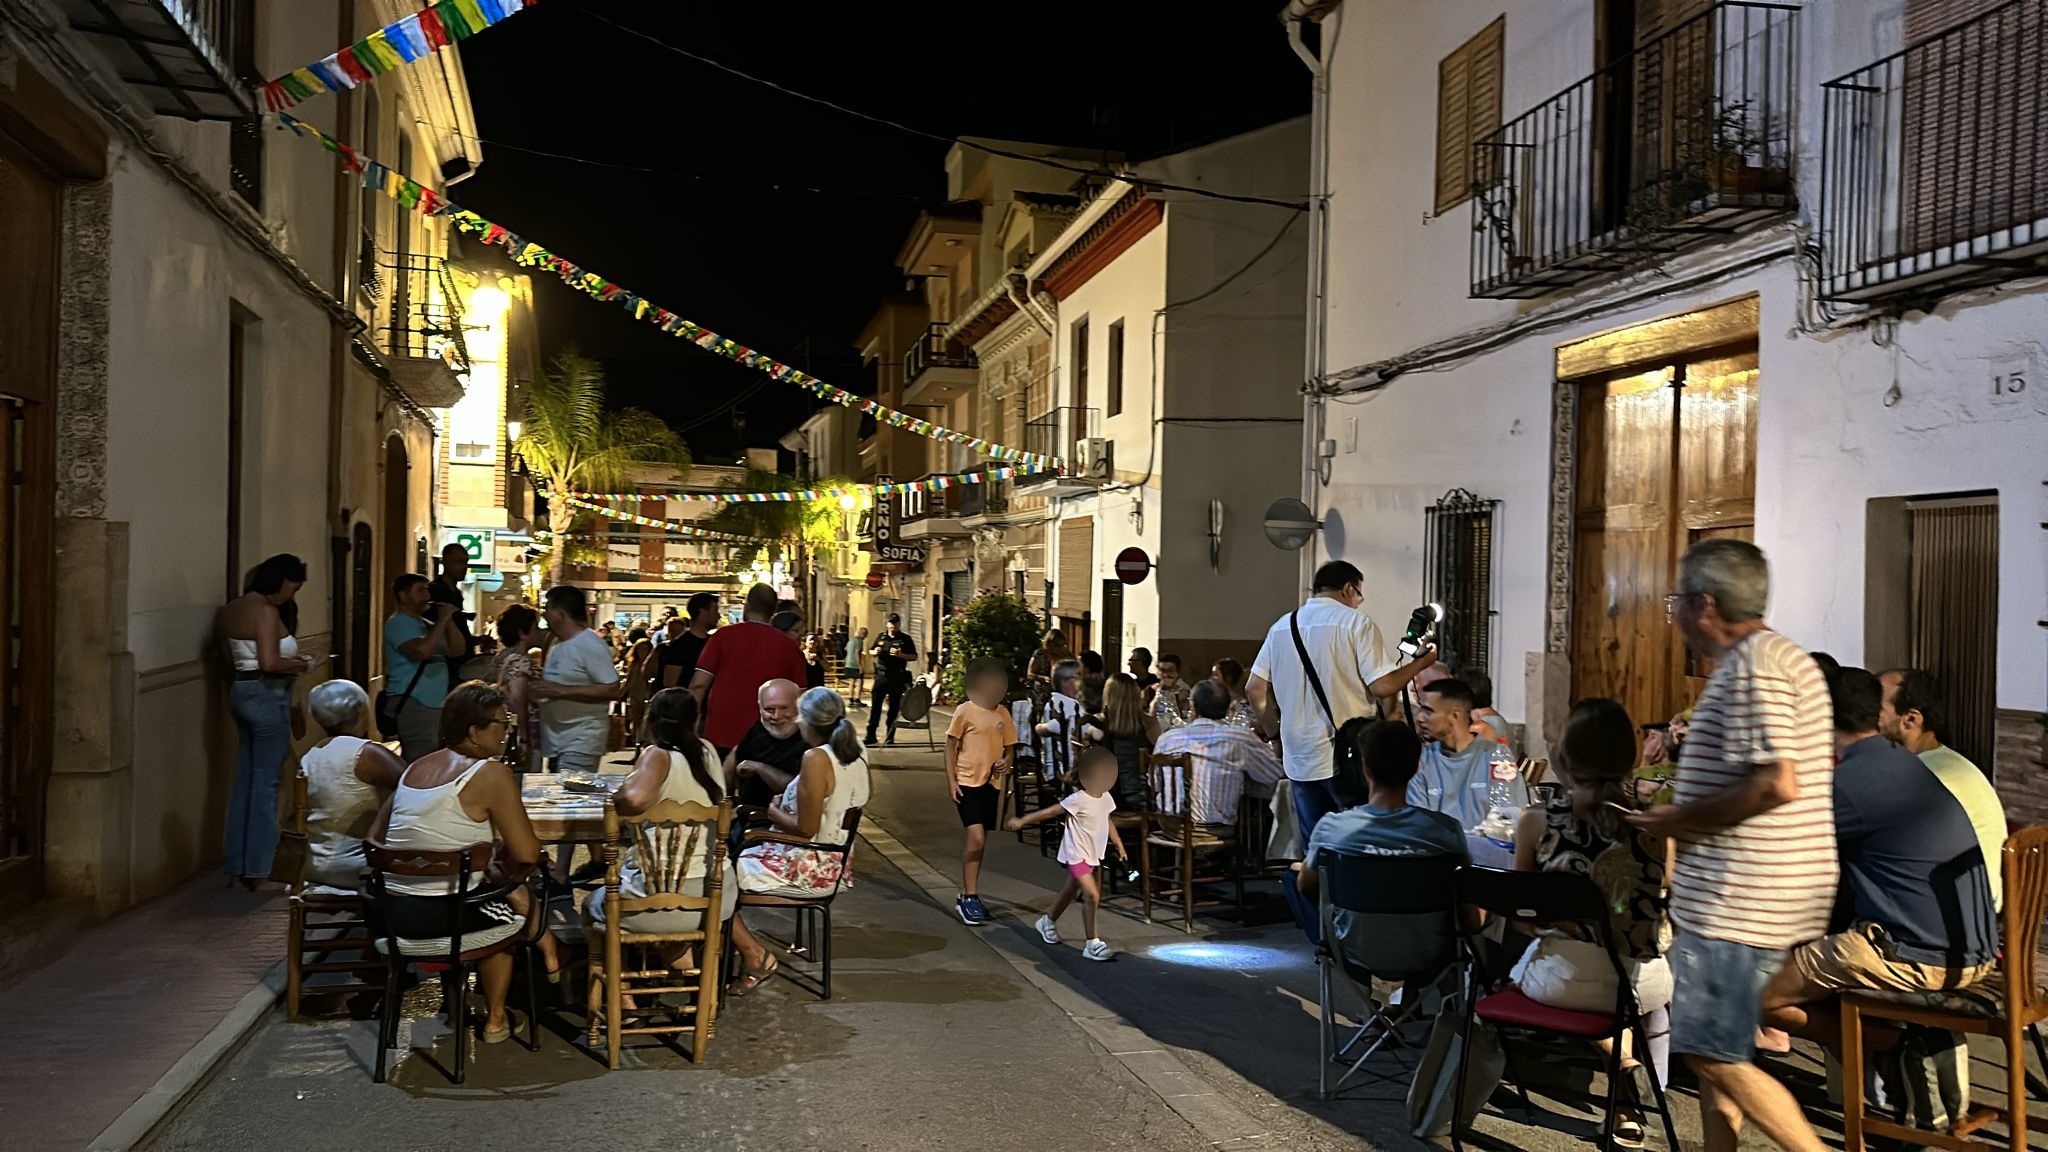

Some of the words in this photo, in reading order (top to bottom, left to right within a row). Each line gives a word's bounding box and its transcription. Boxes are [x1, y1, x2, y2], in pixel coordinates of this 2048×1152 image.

[1993, 371, 2025, 395] 15
[878, 477, 890, 540] HORNO
[882, 547, 920, 560] SOFIA
